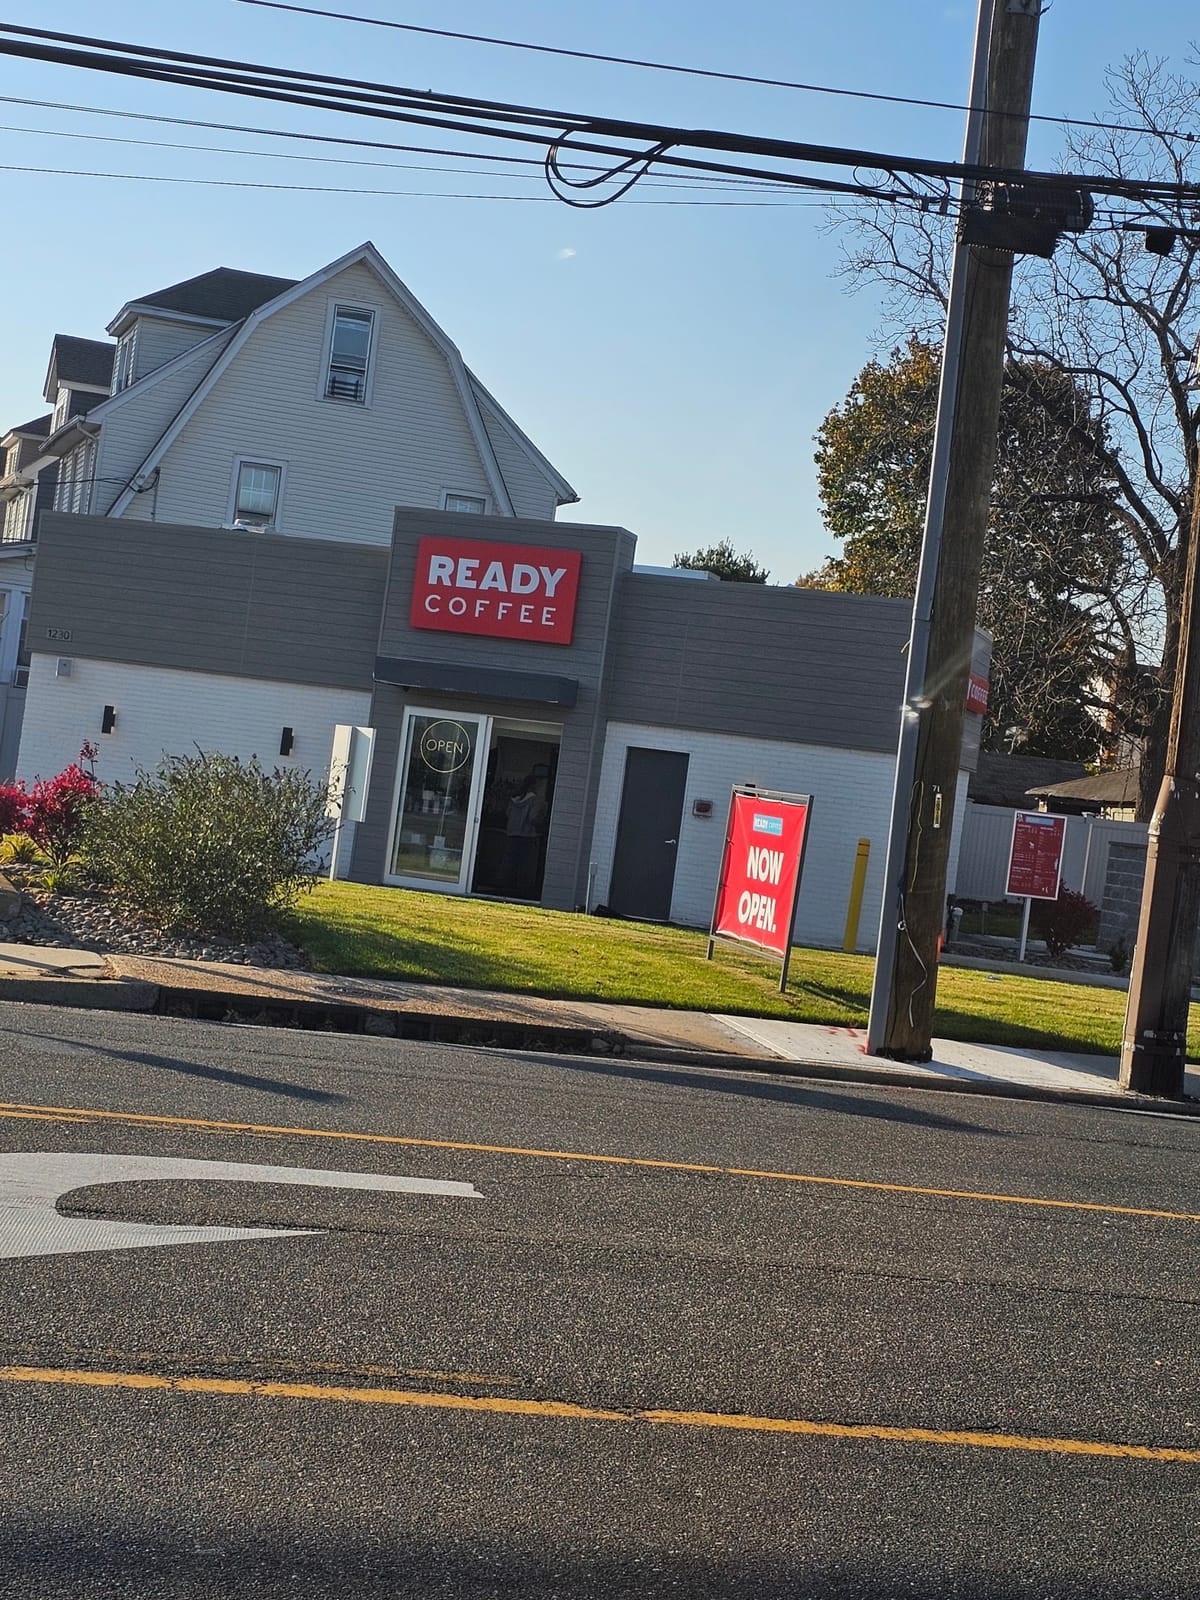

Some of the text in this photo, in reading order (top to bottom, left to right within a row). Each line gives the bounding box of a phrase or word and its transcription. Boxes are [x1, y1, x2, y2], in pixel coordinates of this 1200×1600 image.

[428, 554, 567, 598] READY
[424, 594, 557, 626] COFFEE
[426, 739, 463, 754] OPEN
[746, 845, 784, 885] NOW
[737, 890, 777, 933] OPEN.
